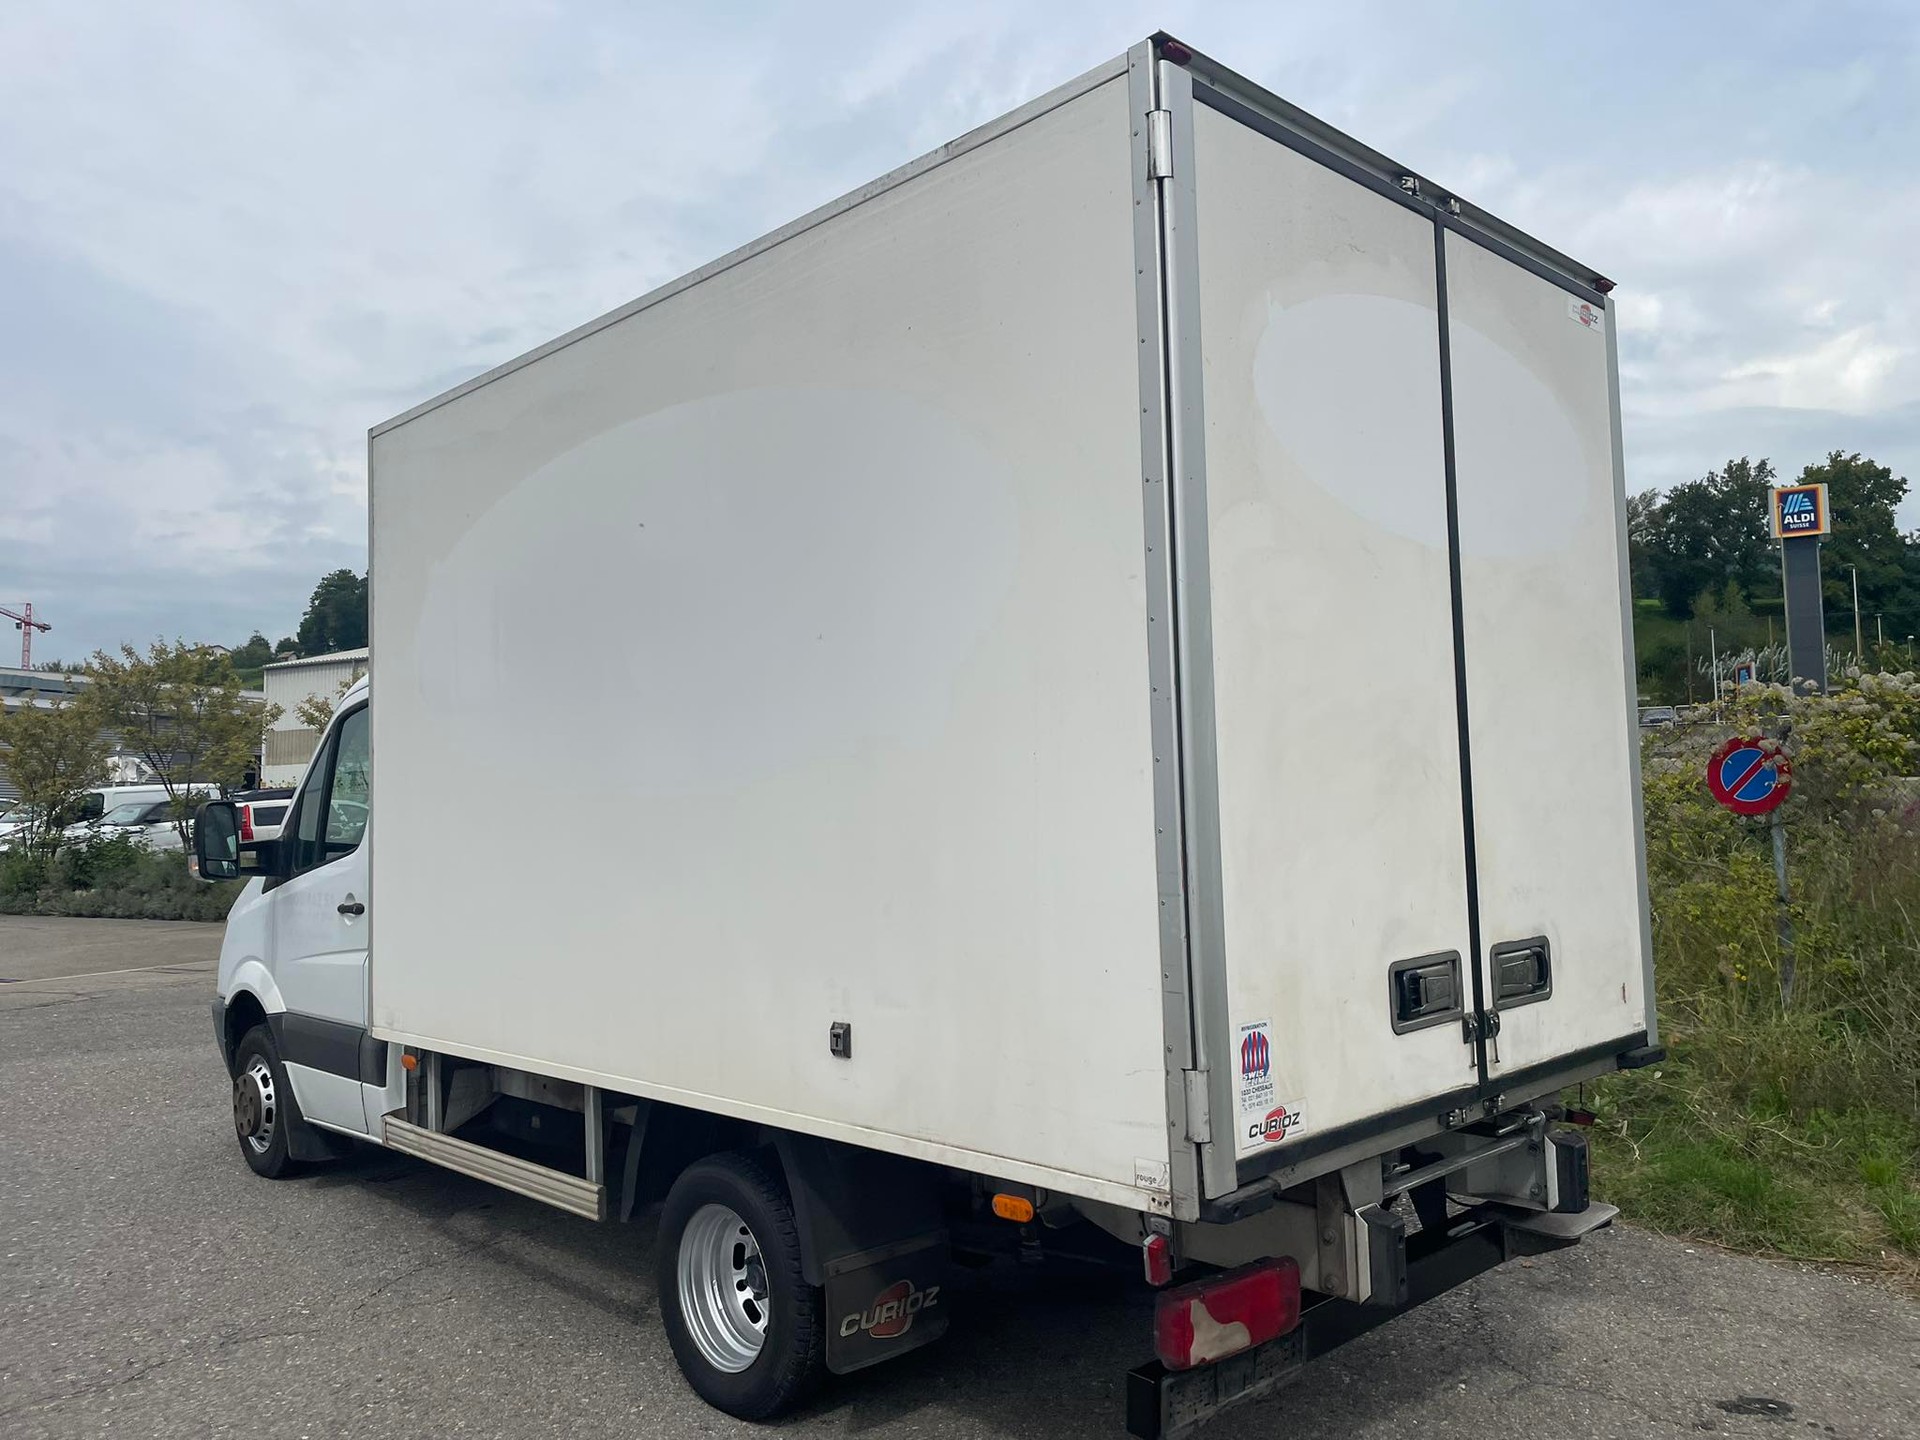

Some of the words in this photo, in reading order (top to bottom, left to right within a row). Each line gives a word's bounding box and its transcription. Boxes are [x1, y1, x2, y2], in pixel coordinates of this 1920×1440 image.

[1783, 512, 1815, 524] ALDI
[1249, 1111, 1301, 1138] CURIOZ
[1136, 1173, 1157, 1185] rouge
[839, 1285, 940, 1337] CURIOZ
